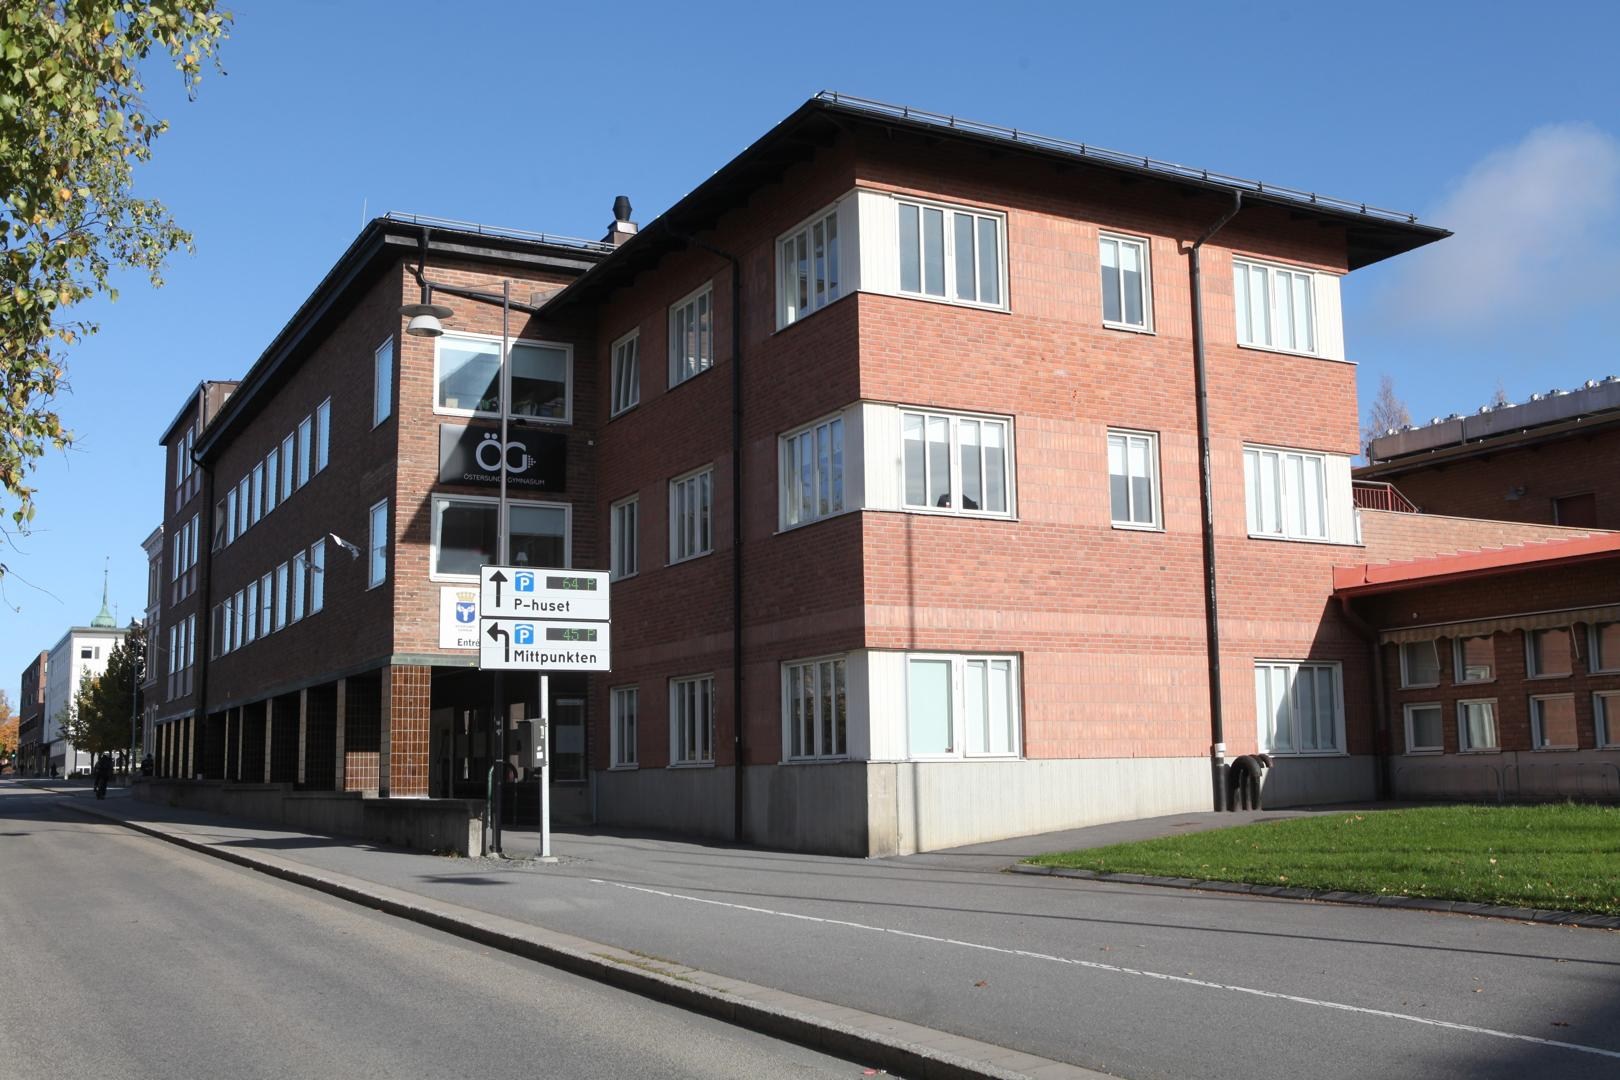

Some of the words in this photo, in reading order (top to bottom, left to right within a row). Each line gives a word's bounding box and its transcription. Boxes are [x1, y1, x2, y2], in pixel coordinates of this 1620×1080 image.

[562, 577, 579, 590] 64
[587, 578, 596, 591] P
[514, 598, 570, 612] P-huset
[562, 628, 579, 641] 45
[587, 629, 596, 642] P
[514, 650, 597, 665] Mittpunkten
